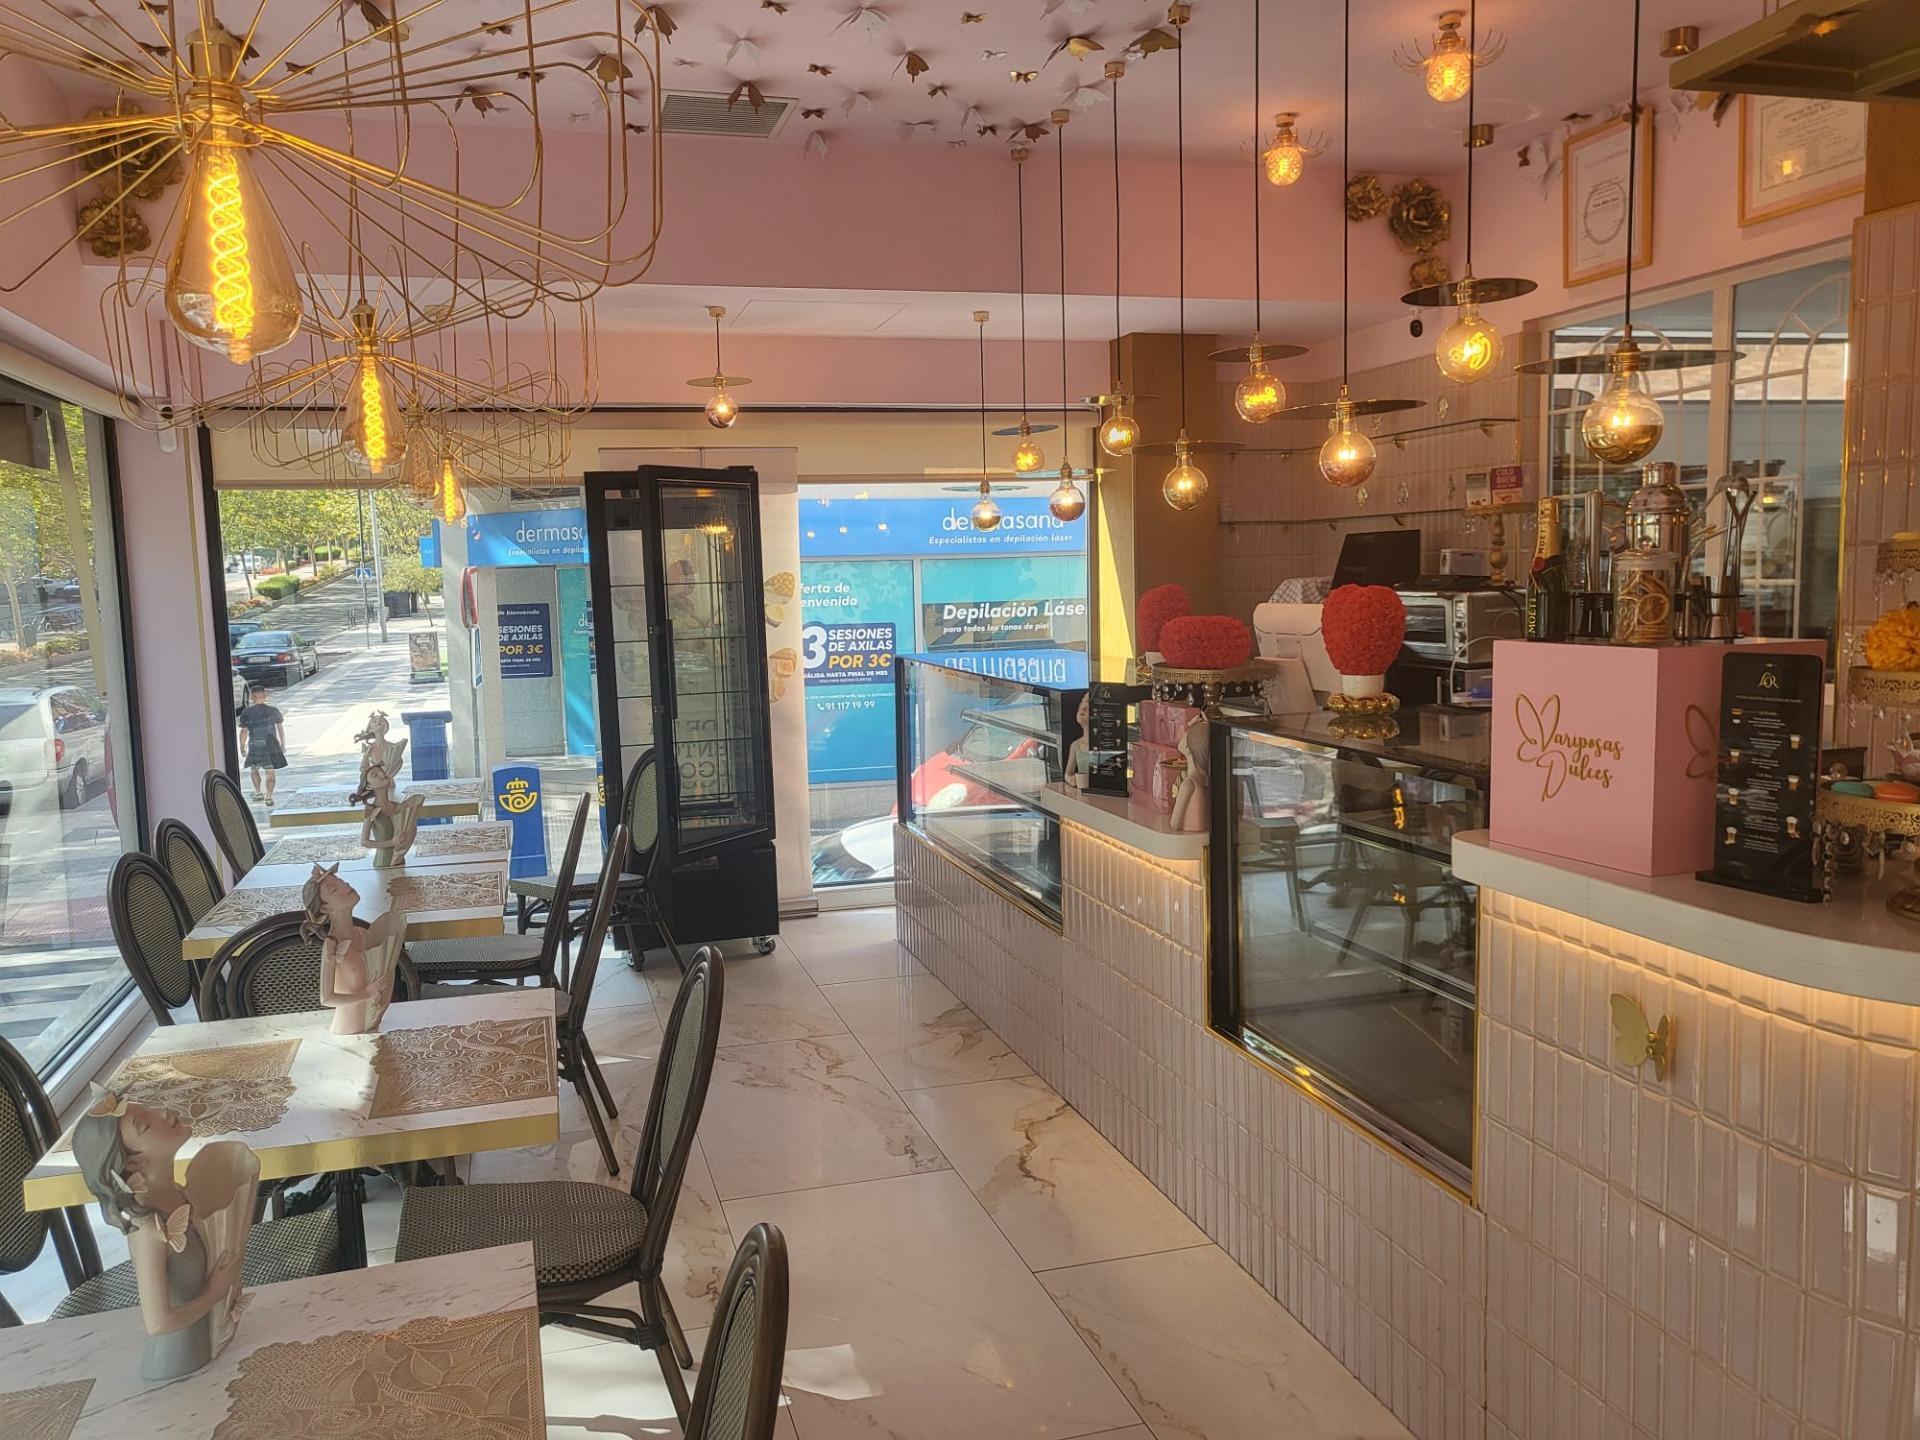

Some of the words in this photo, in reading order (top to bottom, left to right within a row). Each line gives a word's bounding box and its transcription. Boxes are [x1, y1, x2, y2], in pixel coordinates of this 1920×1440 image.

[942, 507, 1064, 531] deasana
[928, 535, 987, 546] Especialistas
[834, 582, 850, 593] de
[943, 603, 1038, 624] Depilación
[498, 624, 543, 634] SESIONES
[943, 626, 962, 634] para
[1000, 623, 1022, 631] tonos
[1023, 622, 1034, 630] de
[511, 633, 543, 641] AXILAS
[828, 628, 893, 641] SESIONES
[500, 644, 524, 655] POR
[527, 644, 544, 654] 3€
[802, 626, 828, 668] 3
[828, 641, 846, 652] DE
[848, 640, 893, 652] AXILAS
[829, 654, 864, 669] POR
[868, 653, 892, 668] 3€
[825, 702, 835, 710] 91
[837, 702, 850, 710] 117
[852, 701, 862, 709] 19
[864, 701, 876, 709] 99
[1515, 693, 1624, 764] Mariposas
[1536, 750, 1614, 802] Dulces
